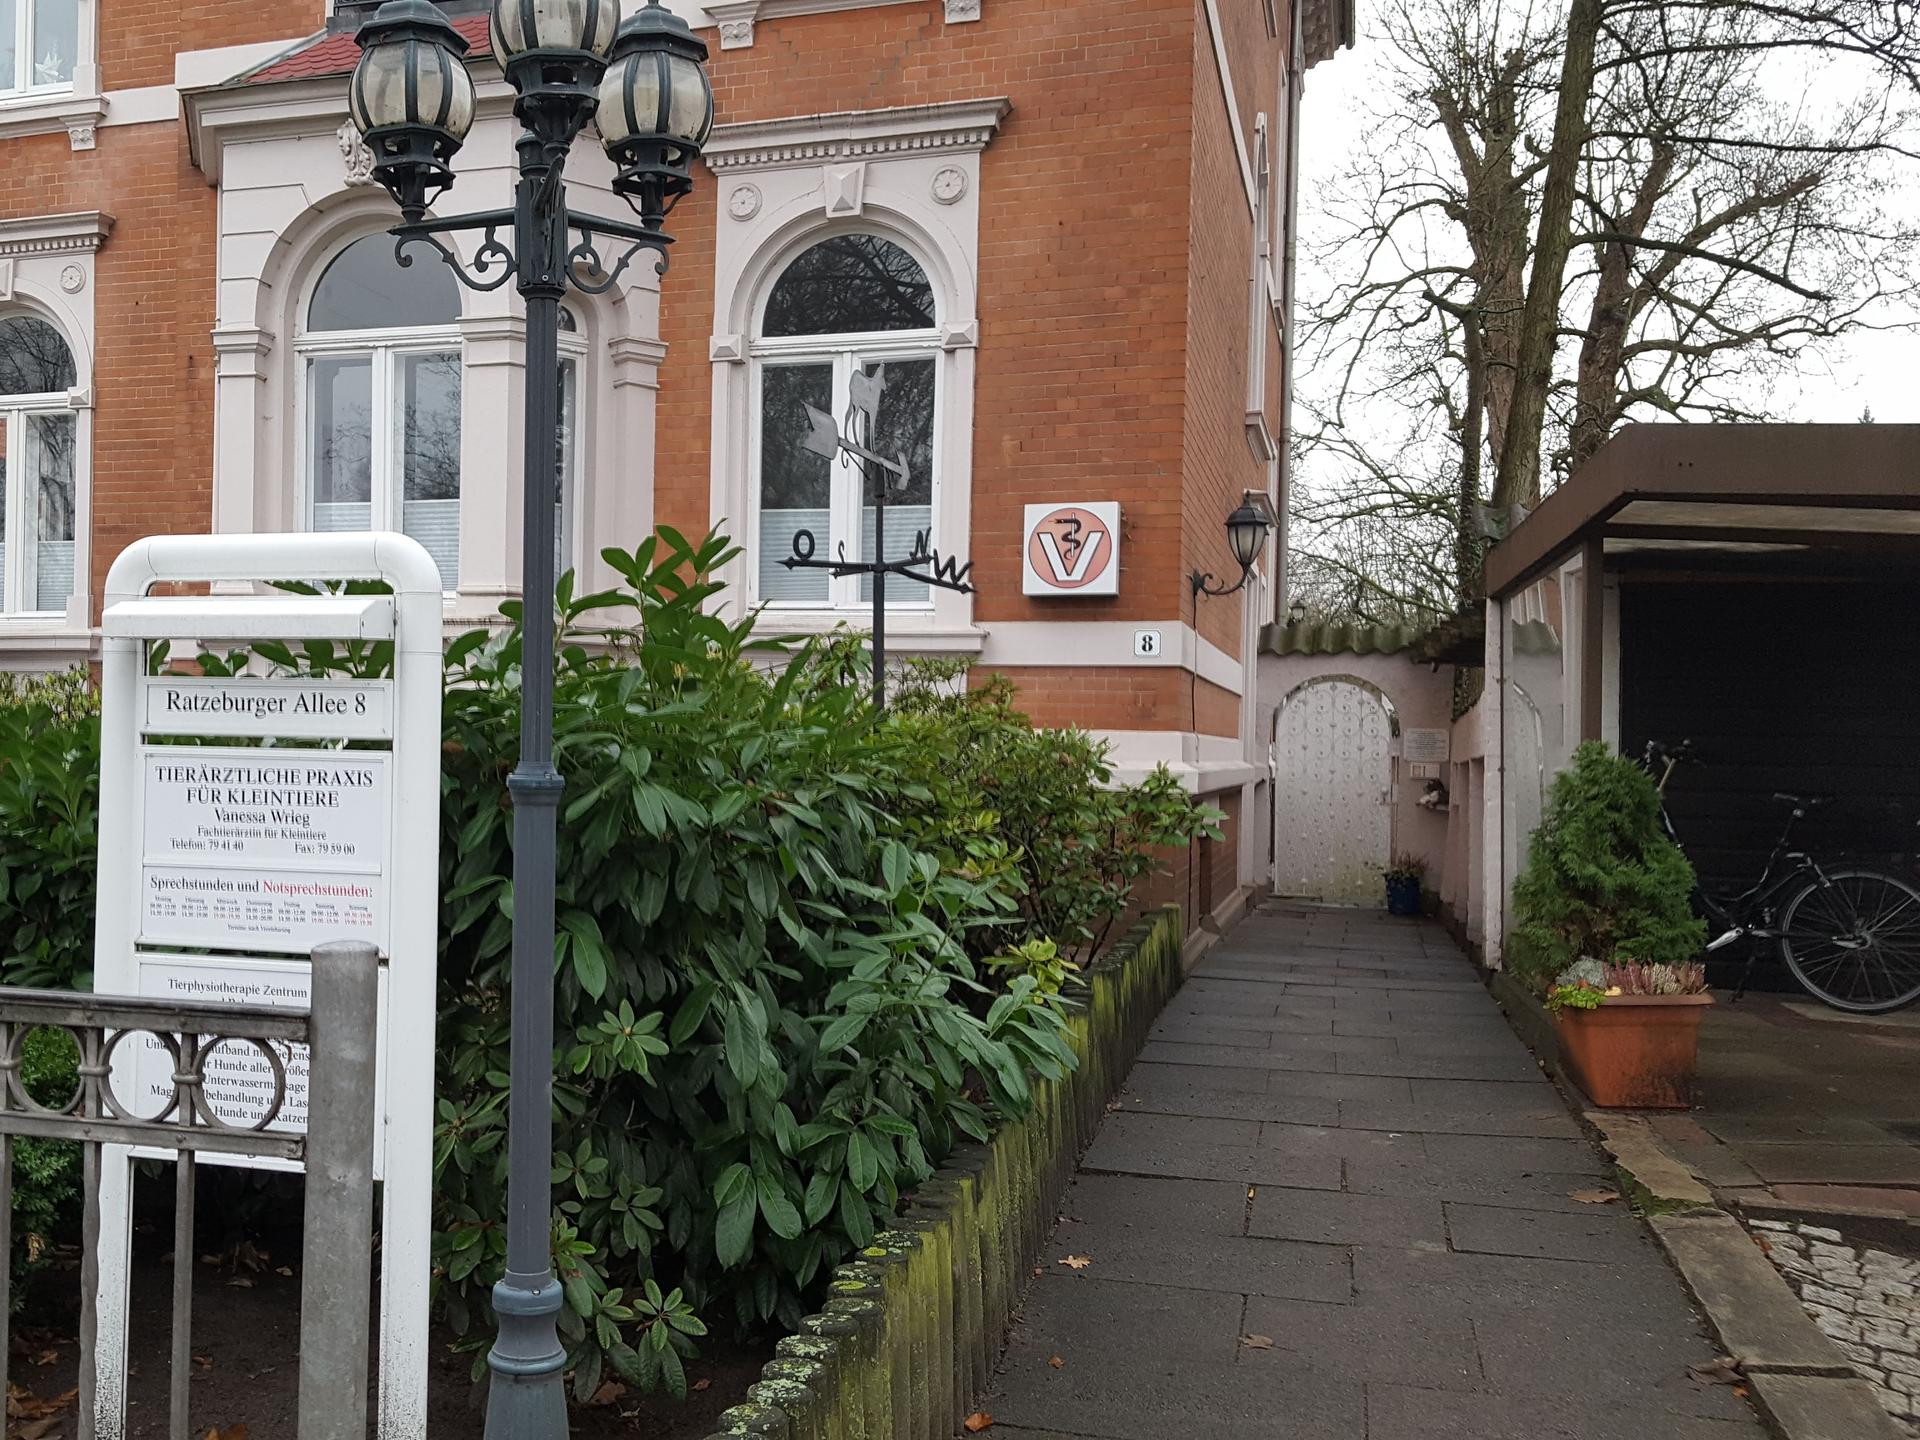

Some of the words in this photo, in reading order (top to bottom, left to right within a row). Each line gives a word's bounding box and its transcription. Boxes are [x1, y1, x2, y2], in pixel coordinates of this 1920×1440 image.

[1037, 530, 1104, 582] V
[1141, 634, 1153, 652] 8
[166, 690, 287, 718] Ratzeburger
[293, 692, 348, 714] Allee
[354, 693, 366, 715] 8
[155, 764, 301, 786] TIERÄRZTLICHE
[306, 769, 373, 788] PRAXIS
[186, 785, 222, 805] FÜR
[227, 788, 340, 808] KLEINTIERE
[215, 808, 266, 824] Vanessa
[197, 825, 262, 839] Fachtierärztin
[264, 828, 278, 840] für
[280, 828, 327, 841] Kleintiere
[170, 839, 206, 851] Telefon:
[209, 840, 219, 851] 79
[294, 842, 315, 854] Fax:
[317, 843, 329, 855] 79
[150, 876, 234, 893] Sprechstunden
[237, 879, 259, 893] und
[263, 880, 373, 898] Notsprechstunden:
[168, 979, 261, 997] Tierphysiotherapie
[263, 985, 308, 998] Zentrum
[214, 1058, 248, 1072] Hunde
[214, 1105, 248, 1119] Hunde
